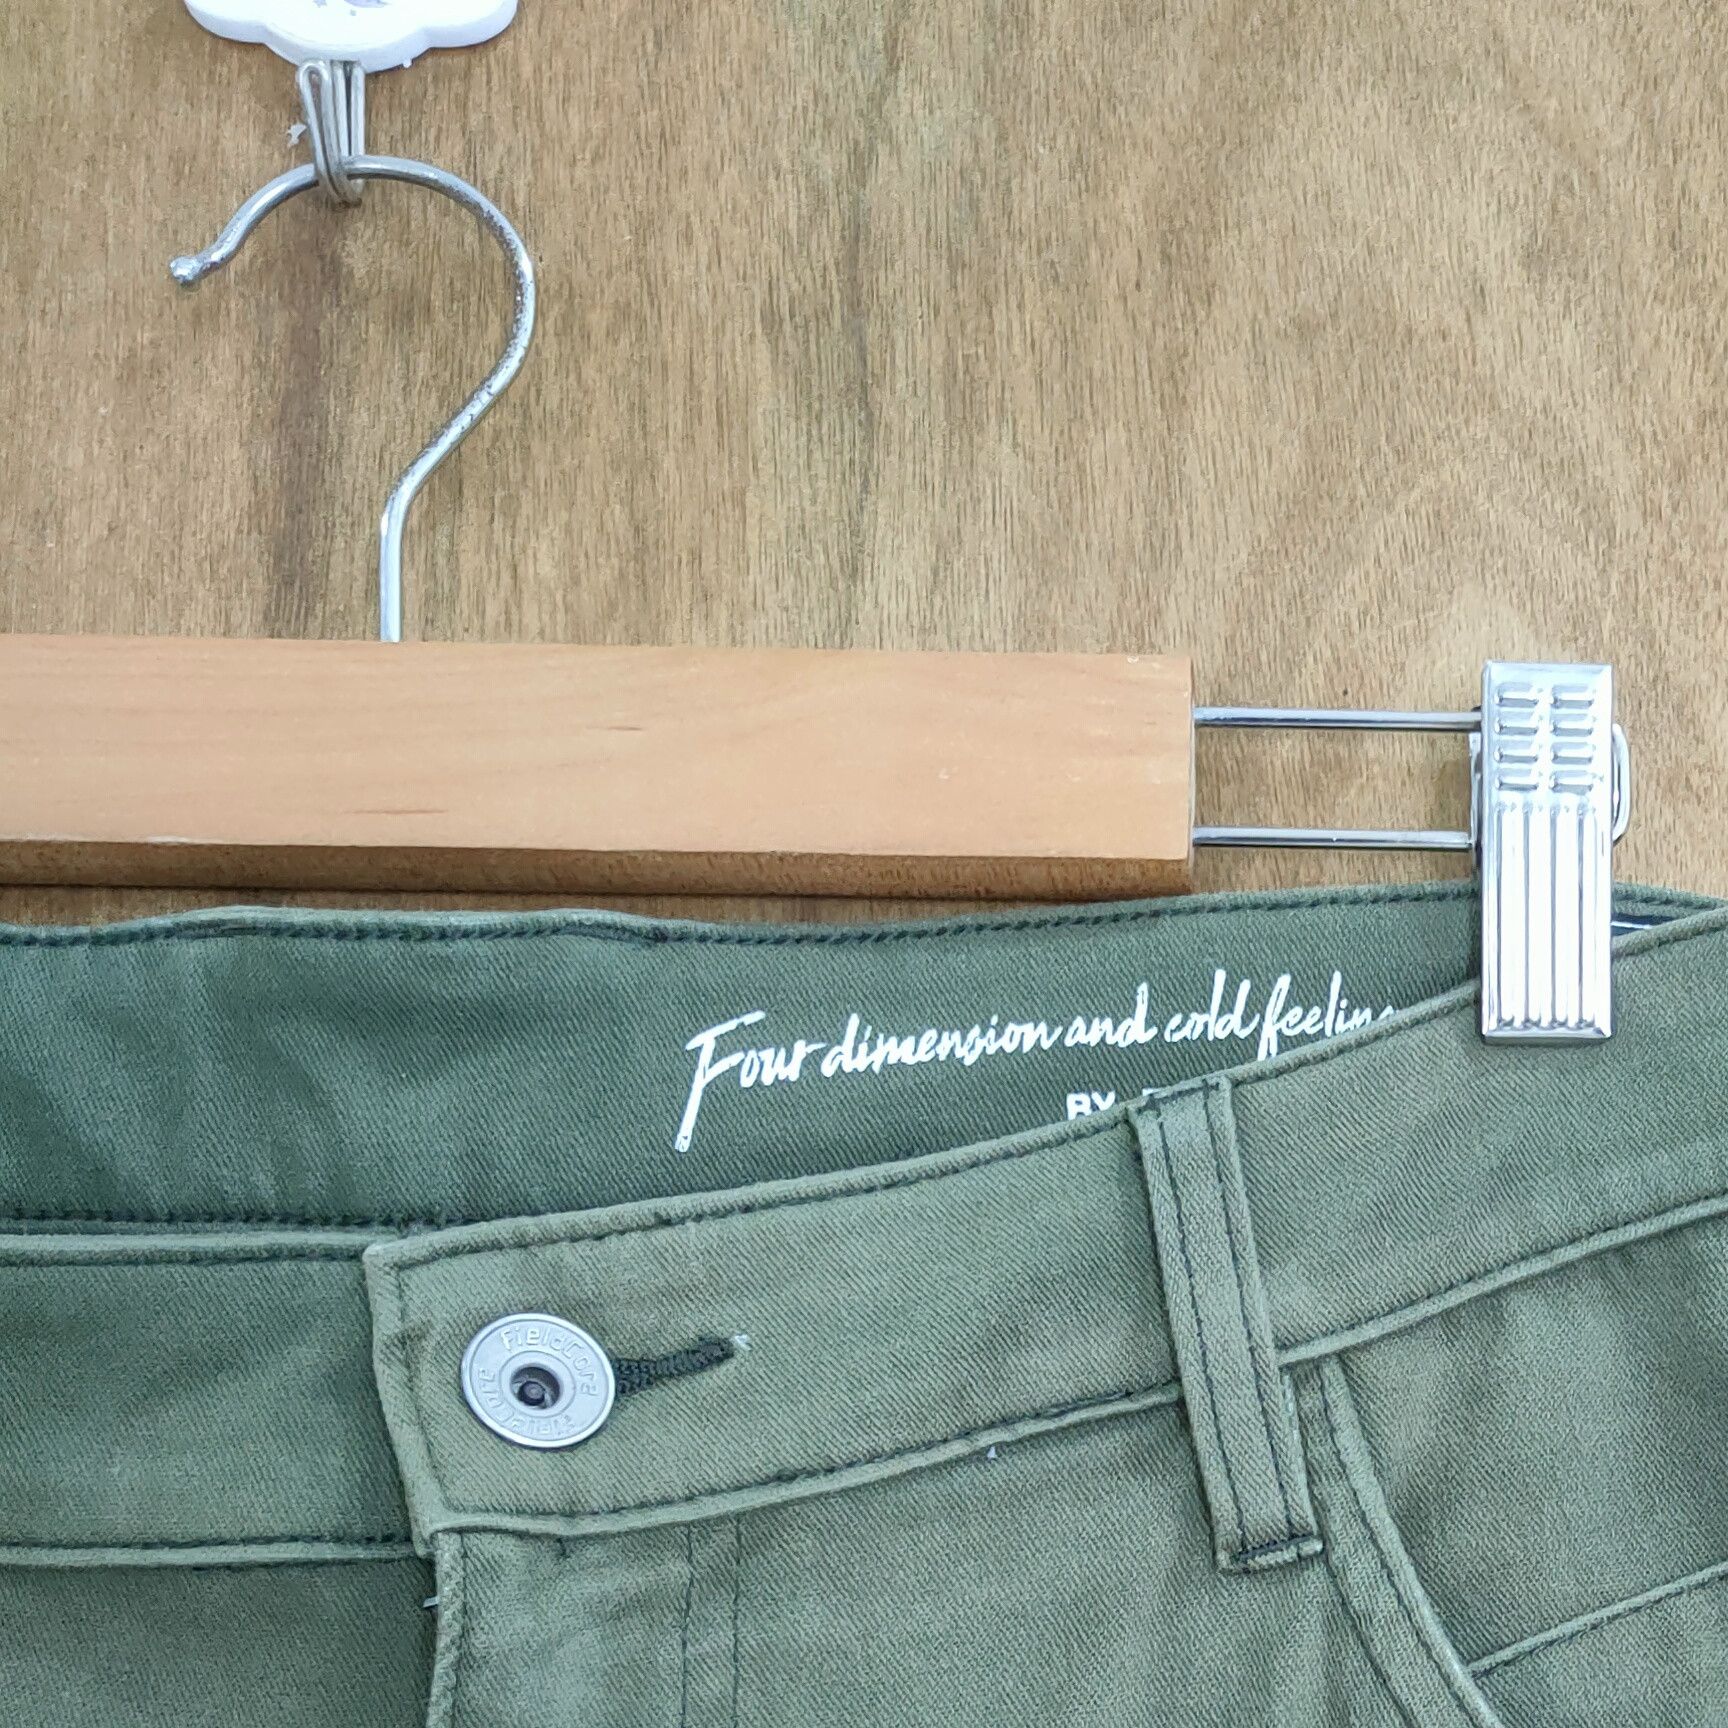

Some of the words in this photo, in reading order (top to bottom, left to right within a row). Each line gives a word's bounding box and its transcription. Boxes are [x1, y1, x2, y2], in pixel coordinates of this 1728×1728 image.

[674, 1009, 827, 1152] Four
[820, 1013, 1063, 1077] dimension
[1064, 982, 1157, 1047] and
[1164, 968, 1260, 1042] cold
[1257, 970, 1400, 1061] feelin
